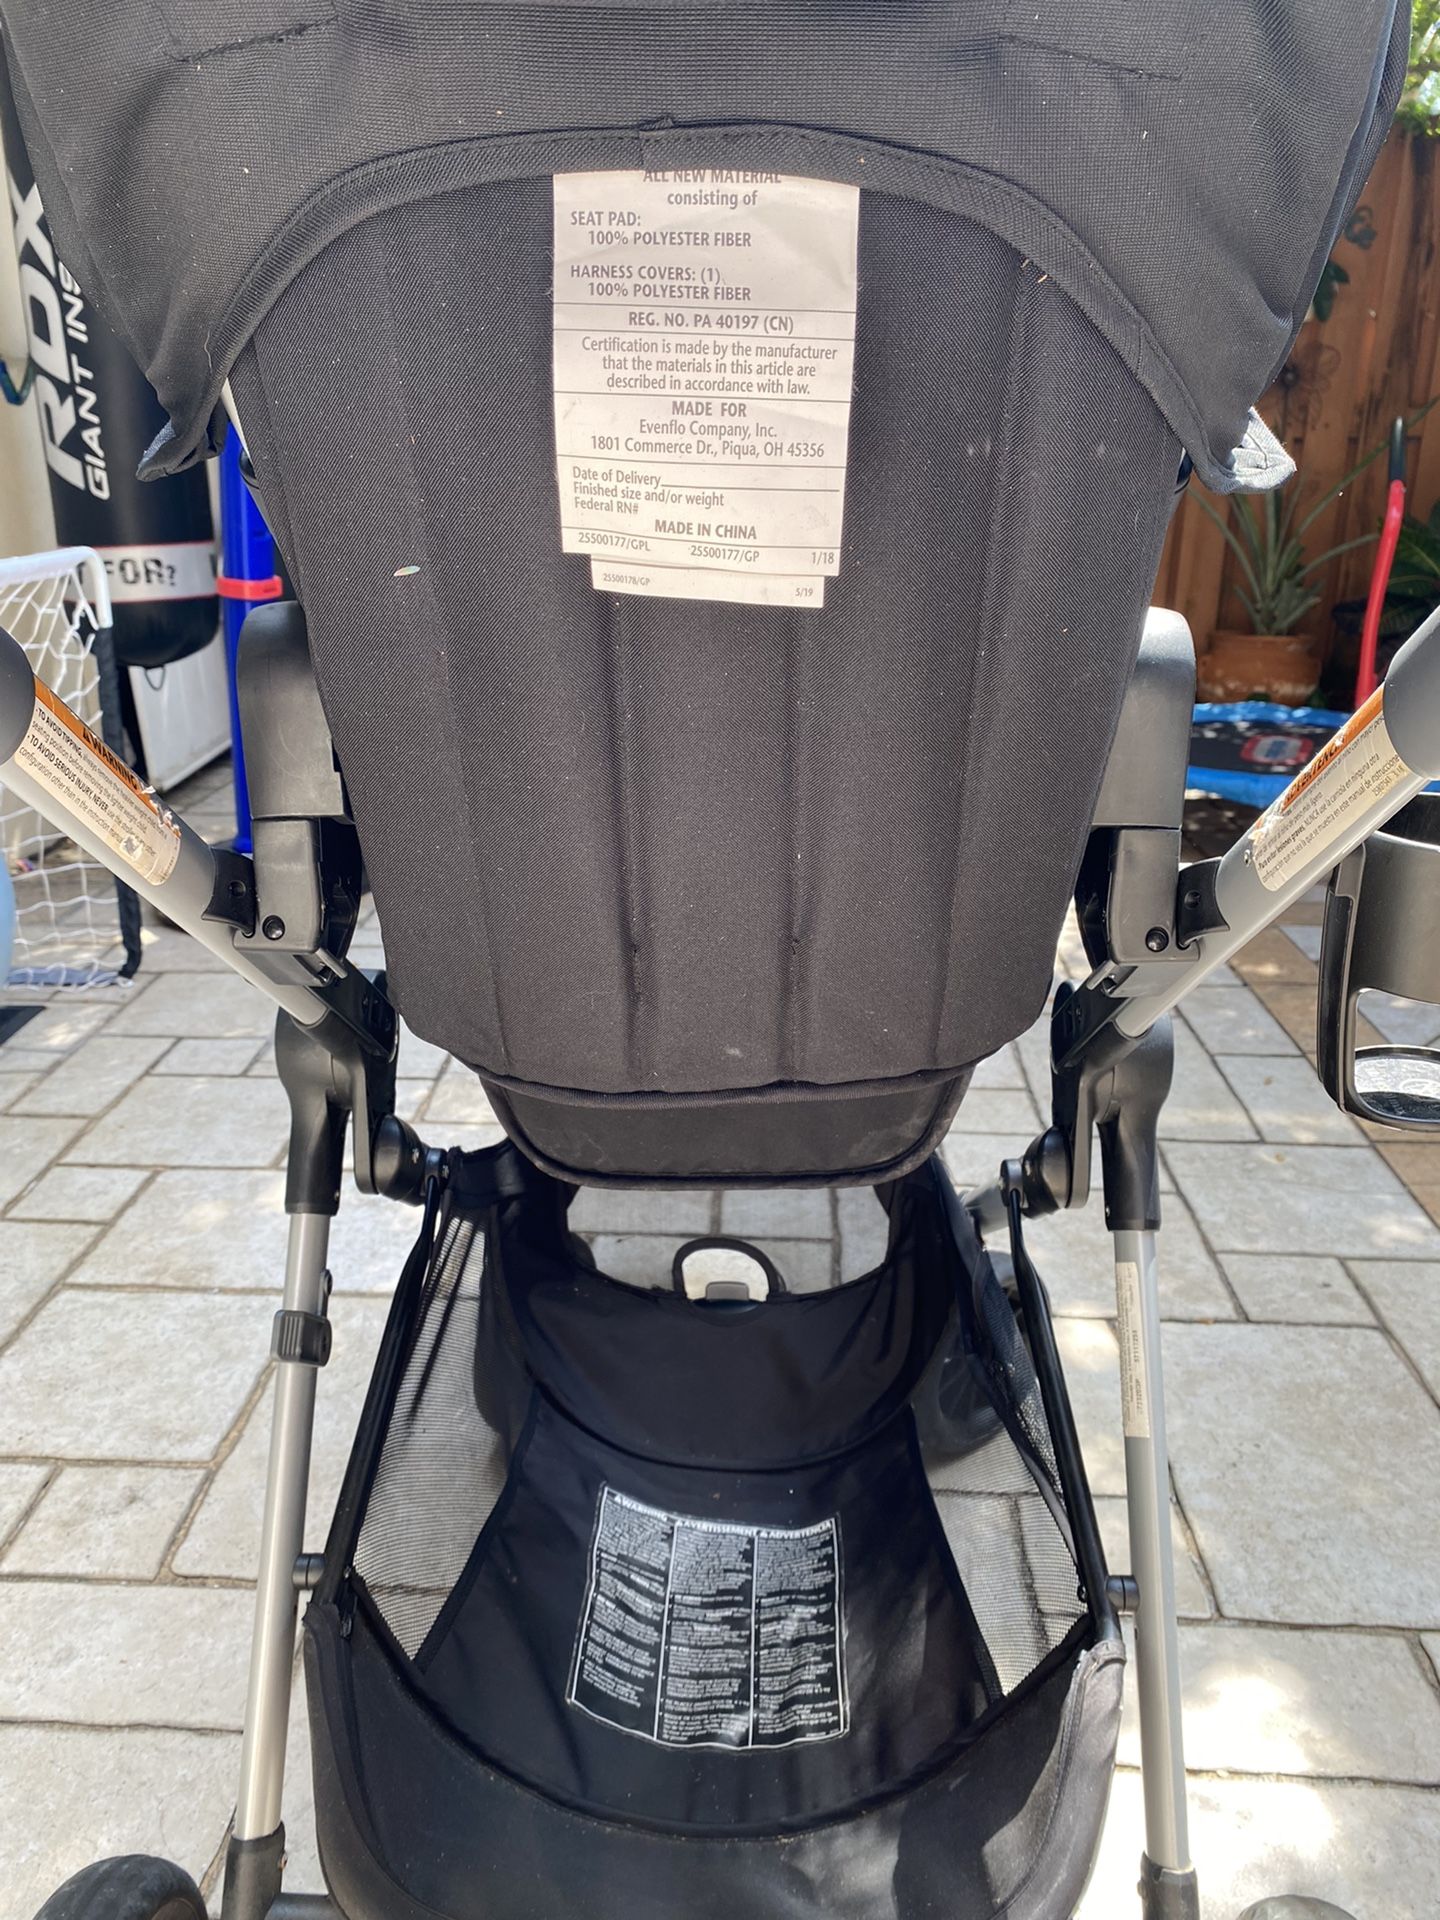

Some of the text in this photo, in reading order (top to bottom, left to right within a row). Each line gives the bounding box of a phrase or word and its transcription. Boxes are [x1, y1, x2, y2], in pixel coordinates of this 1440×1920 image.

[643, 170, 782, 183] ALL NEW MATERIAL
[668, 190, 758, 209] consisting of
[570, 212, 641, 226] SEAT PAD:
[588, 231, 751, 247] 100% POLYESTER FIBER
[570, 265, 632, 279] HARNESS
[638, 267, 696, 281] COVERS:
[588, 283, 751, 301] 100% POLYESTER FIBER
[7, 165, 86, 491] RDX
[629, 312, 794, 335] REG. NO. PA 40197 (CN)
[582, 336, 837, 360] Certification is made by the manufacturer
[603, 355, 816, 377] that the materials in this article are
[607, 373, 810, 395] described in accordance with law.
[672, 401, 746, 417] MADE FOR
[69, 353, 110, 500] GIANT
[639, 419, 777, 440] Evenflo Company, Inc.
[591, 436, 824, 459] 1801 Commerce Dr., Piqua, OH 45356
[573, 466, 661, 489] Date of Delivery
[573, 482, 724, 509] Finished size and/or weight
[575, 497, 638, 514] Federal RN#
[655, 519, 757, 540] MADE IN CHINA
[578, 532, 835, 565] 25500177/GPL 25500177/GP 1/18
[795, 588, 814, 597] 5/19
[36, 709, 46, 720] TO
[18, 746, 53, 778] configuration
[50, 774, 66, 790] other
[62, 786, 76, 800] than
[29, 735, 39, 745] TO
[37, 743, 56, 761] AVOID
[53, 758, 77, 781] SERIOUS
[74, 778, 94, 798] INJURY,
[91, 794, 109, 811] NEVER
